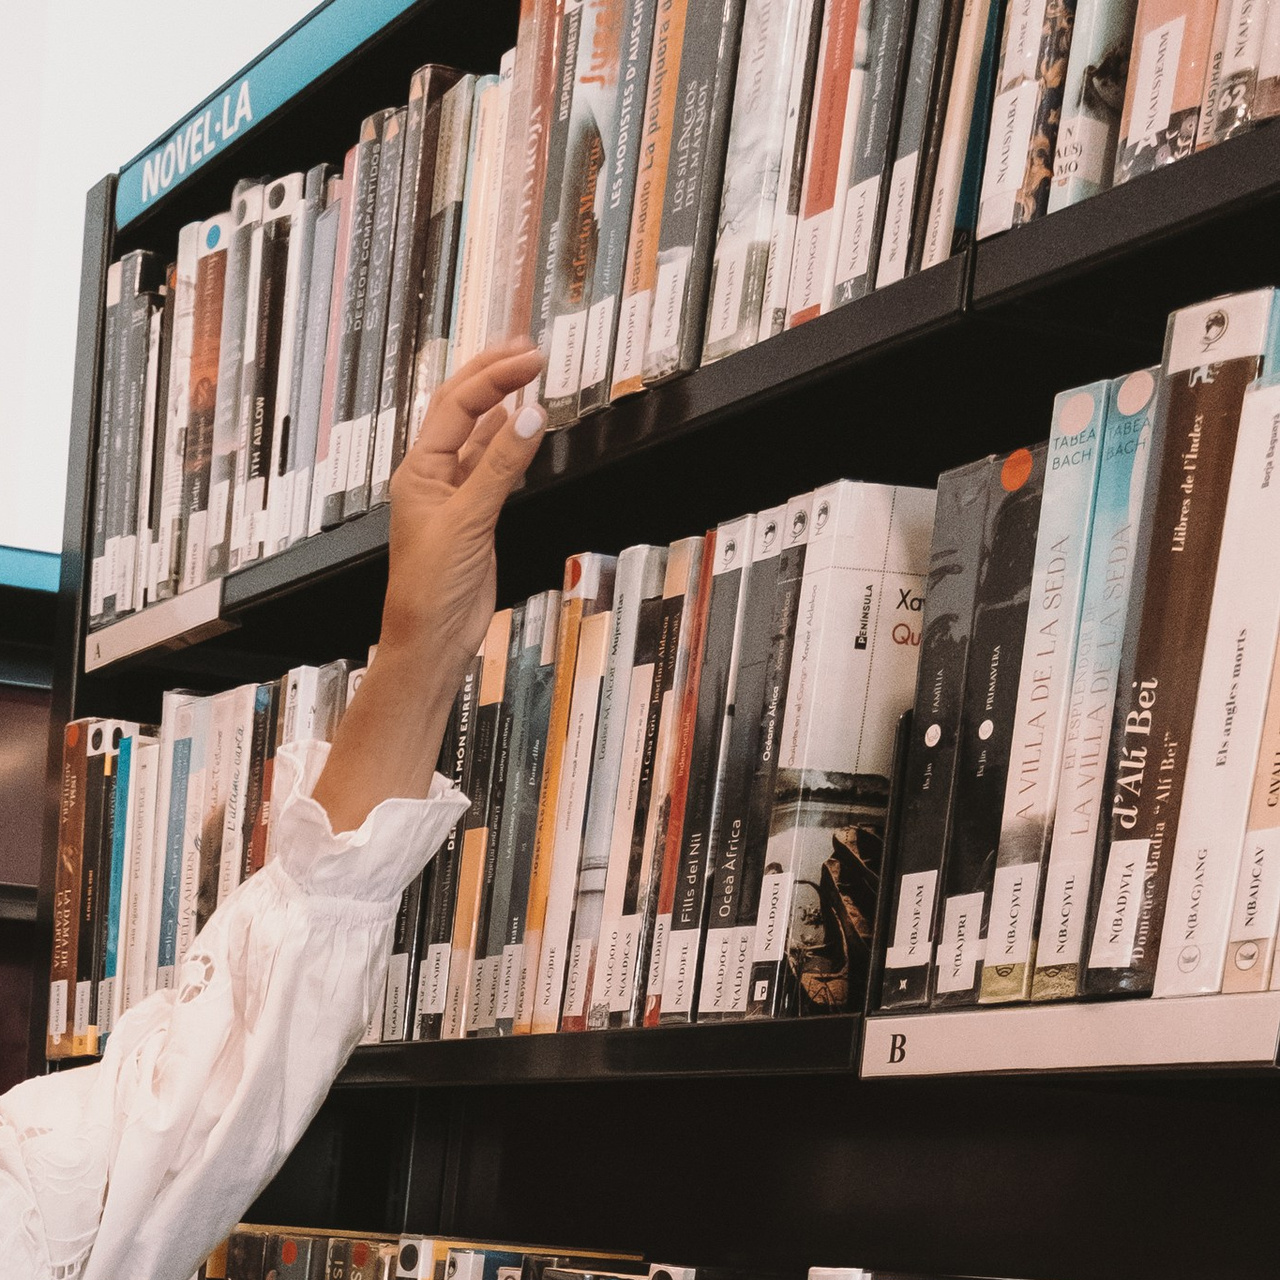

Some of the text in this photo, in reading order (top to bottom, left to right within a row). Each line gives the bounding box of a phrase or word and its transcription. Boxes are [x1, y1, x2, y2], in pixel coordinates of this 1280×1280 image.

[1016, 22, 1029, 55] JANE
[1144, 31, 1170, 130] N(AUS)EMM
[614, 83, 637, 174] MODISTES
[1202, 51, 1222, 136] N(AUS)HAB
[140, 81, 253, 203] NOVEL·LA
[672, 79, 698, 212] LOS SILENCIOS
[995, 96, 1018, 184] N(AUS)ABA
[362, 143, 381, 260] COMPARTIDOS
[609, 177, 623, 210] LES
[685, 171, 700, 206] DEL
[1029, 534, 1072, 702] DE LA SEDA
[1214, 627, 1248, 768] Els angles morts
[1017, 711, 1047, 795] VILLA
[1069, 703, 1107, 836] LA VILLA
[1111, 676, 1159, 830] d'Alí Bei
[679, 831, 704, 924] Fills del Nil
[762, 881, 782, 953] N(ALD)QUI
[1004, 877, 1024, 955] N(BAC)VIL
[1055, 875, 1076, 955] N(BAC)VIL
[1108, 861, 1136, 944] N(BAD)VIA
[1183, 848, 1209, 940] N(BAG)ANG
[1243, 845, 1266, 928] N(BAI)CAV
[906, 884, 925, 956] N(BA)FAM
[951, 913, 968, 978] N(BA)PRI
[541, 946, 558, 1006] N(ALC)DIE
[887, 1033, 908, 1064] B
